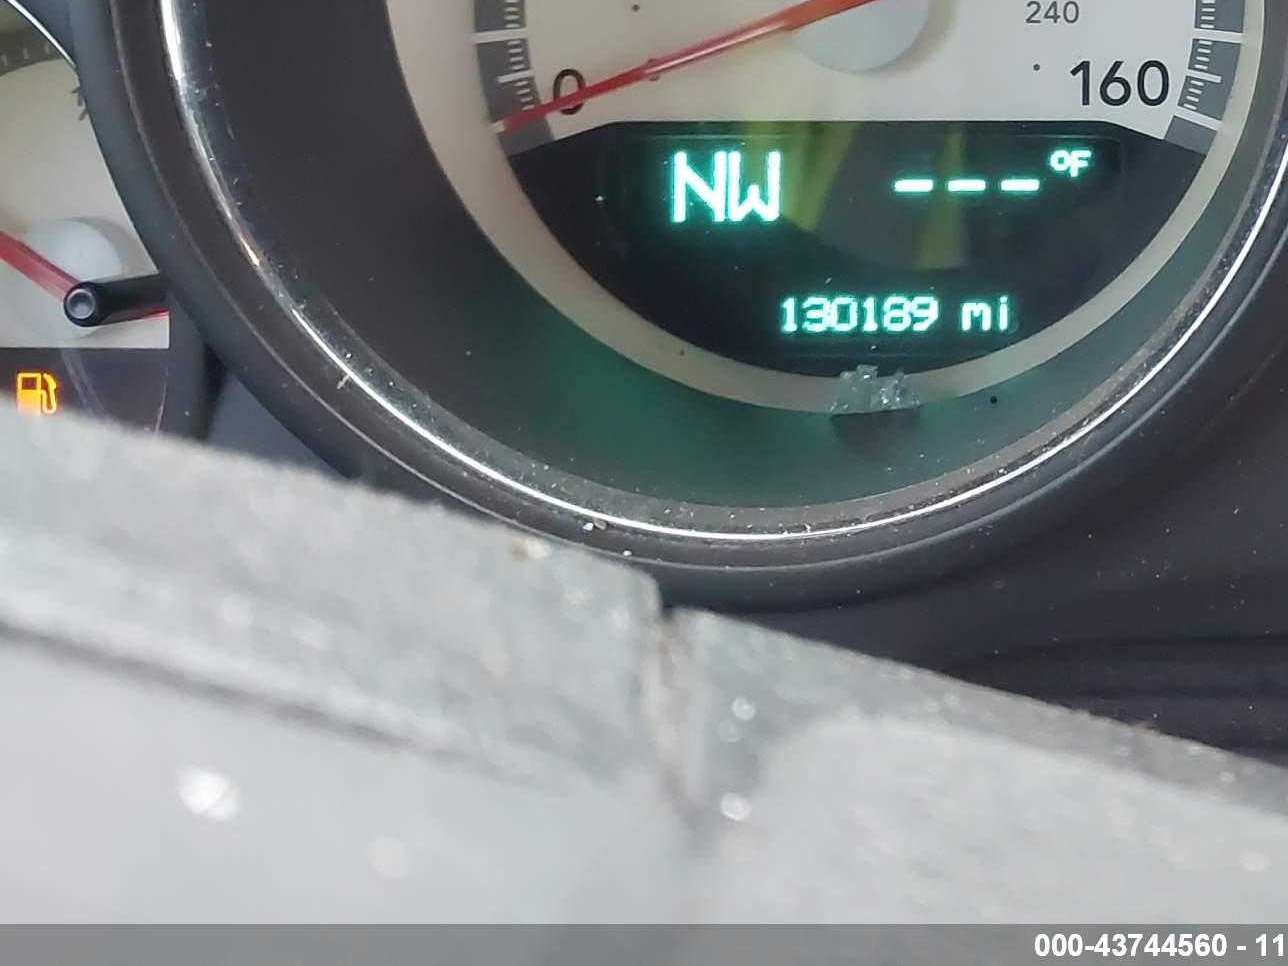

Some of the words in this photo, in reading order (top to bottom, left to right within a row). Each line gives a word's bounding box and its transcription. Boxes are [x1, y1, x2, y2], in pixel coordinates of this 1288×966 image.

[1025, 0, 1080, 25] 240
[552, 69, 586, 116] 0
[1070, 60, 1170, 107] 160
[671, 150, 781, 223] NW
[781, 295, 939, 334] 130189
[961, 296, 1010, 332] mi
